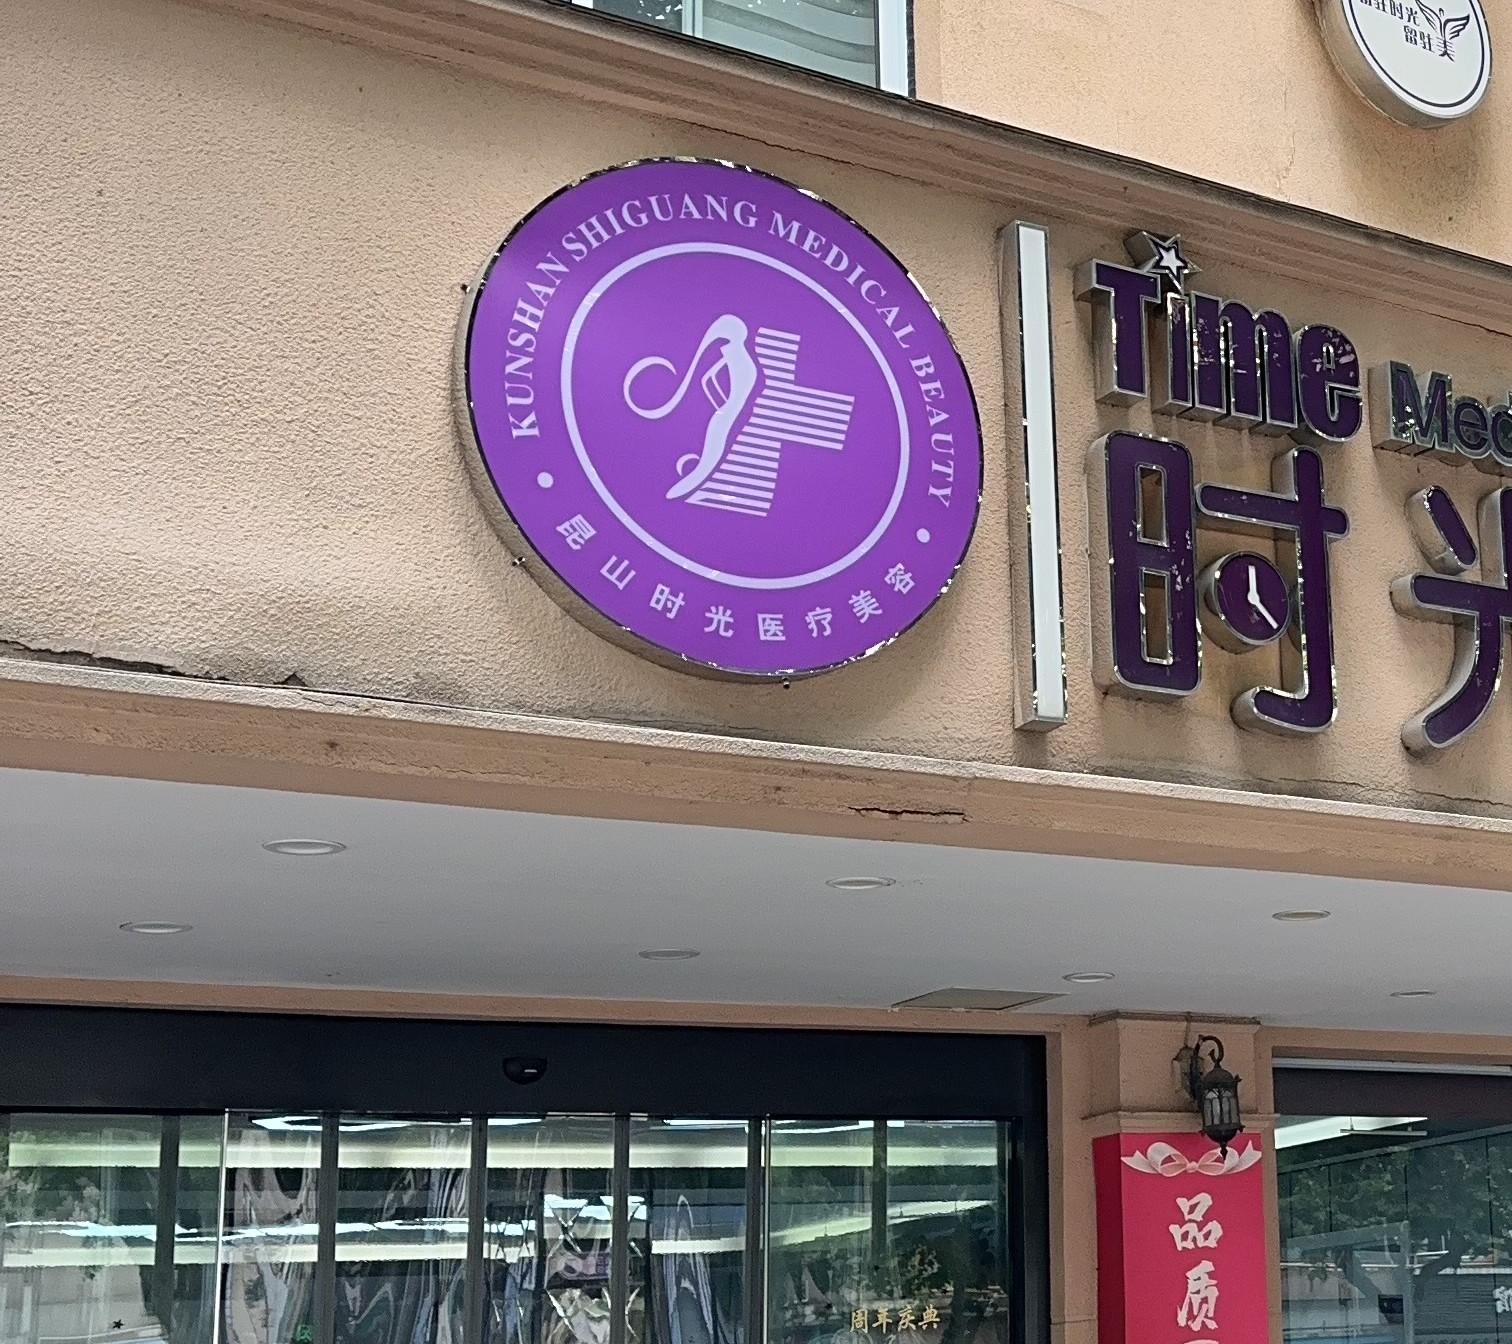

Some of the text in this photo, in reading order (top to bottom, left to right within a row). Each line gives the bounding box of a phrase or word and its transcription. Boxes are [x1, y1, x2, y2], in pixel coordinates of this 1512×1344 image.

[768, 211, 912, 349] MEDICAL
[908, 354, 956, 508] BEAUTY
[1075, 231, 1363, 442] Time
[555, 512, 916, 643] 昆山时光医疗美容
[850, 1304, 941, 1334] 周年庆典
